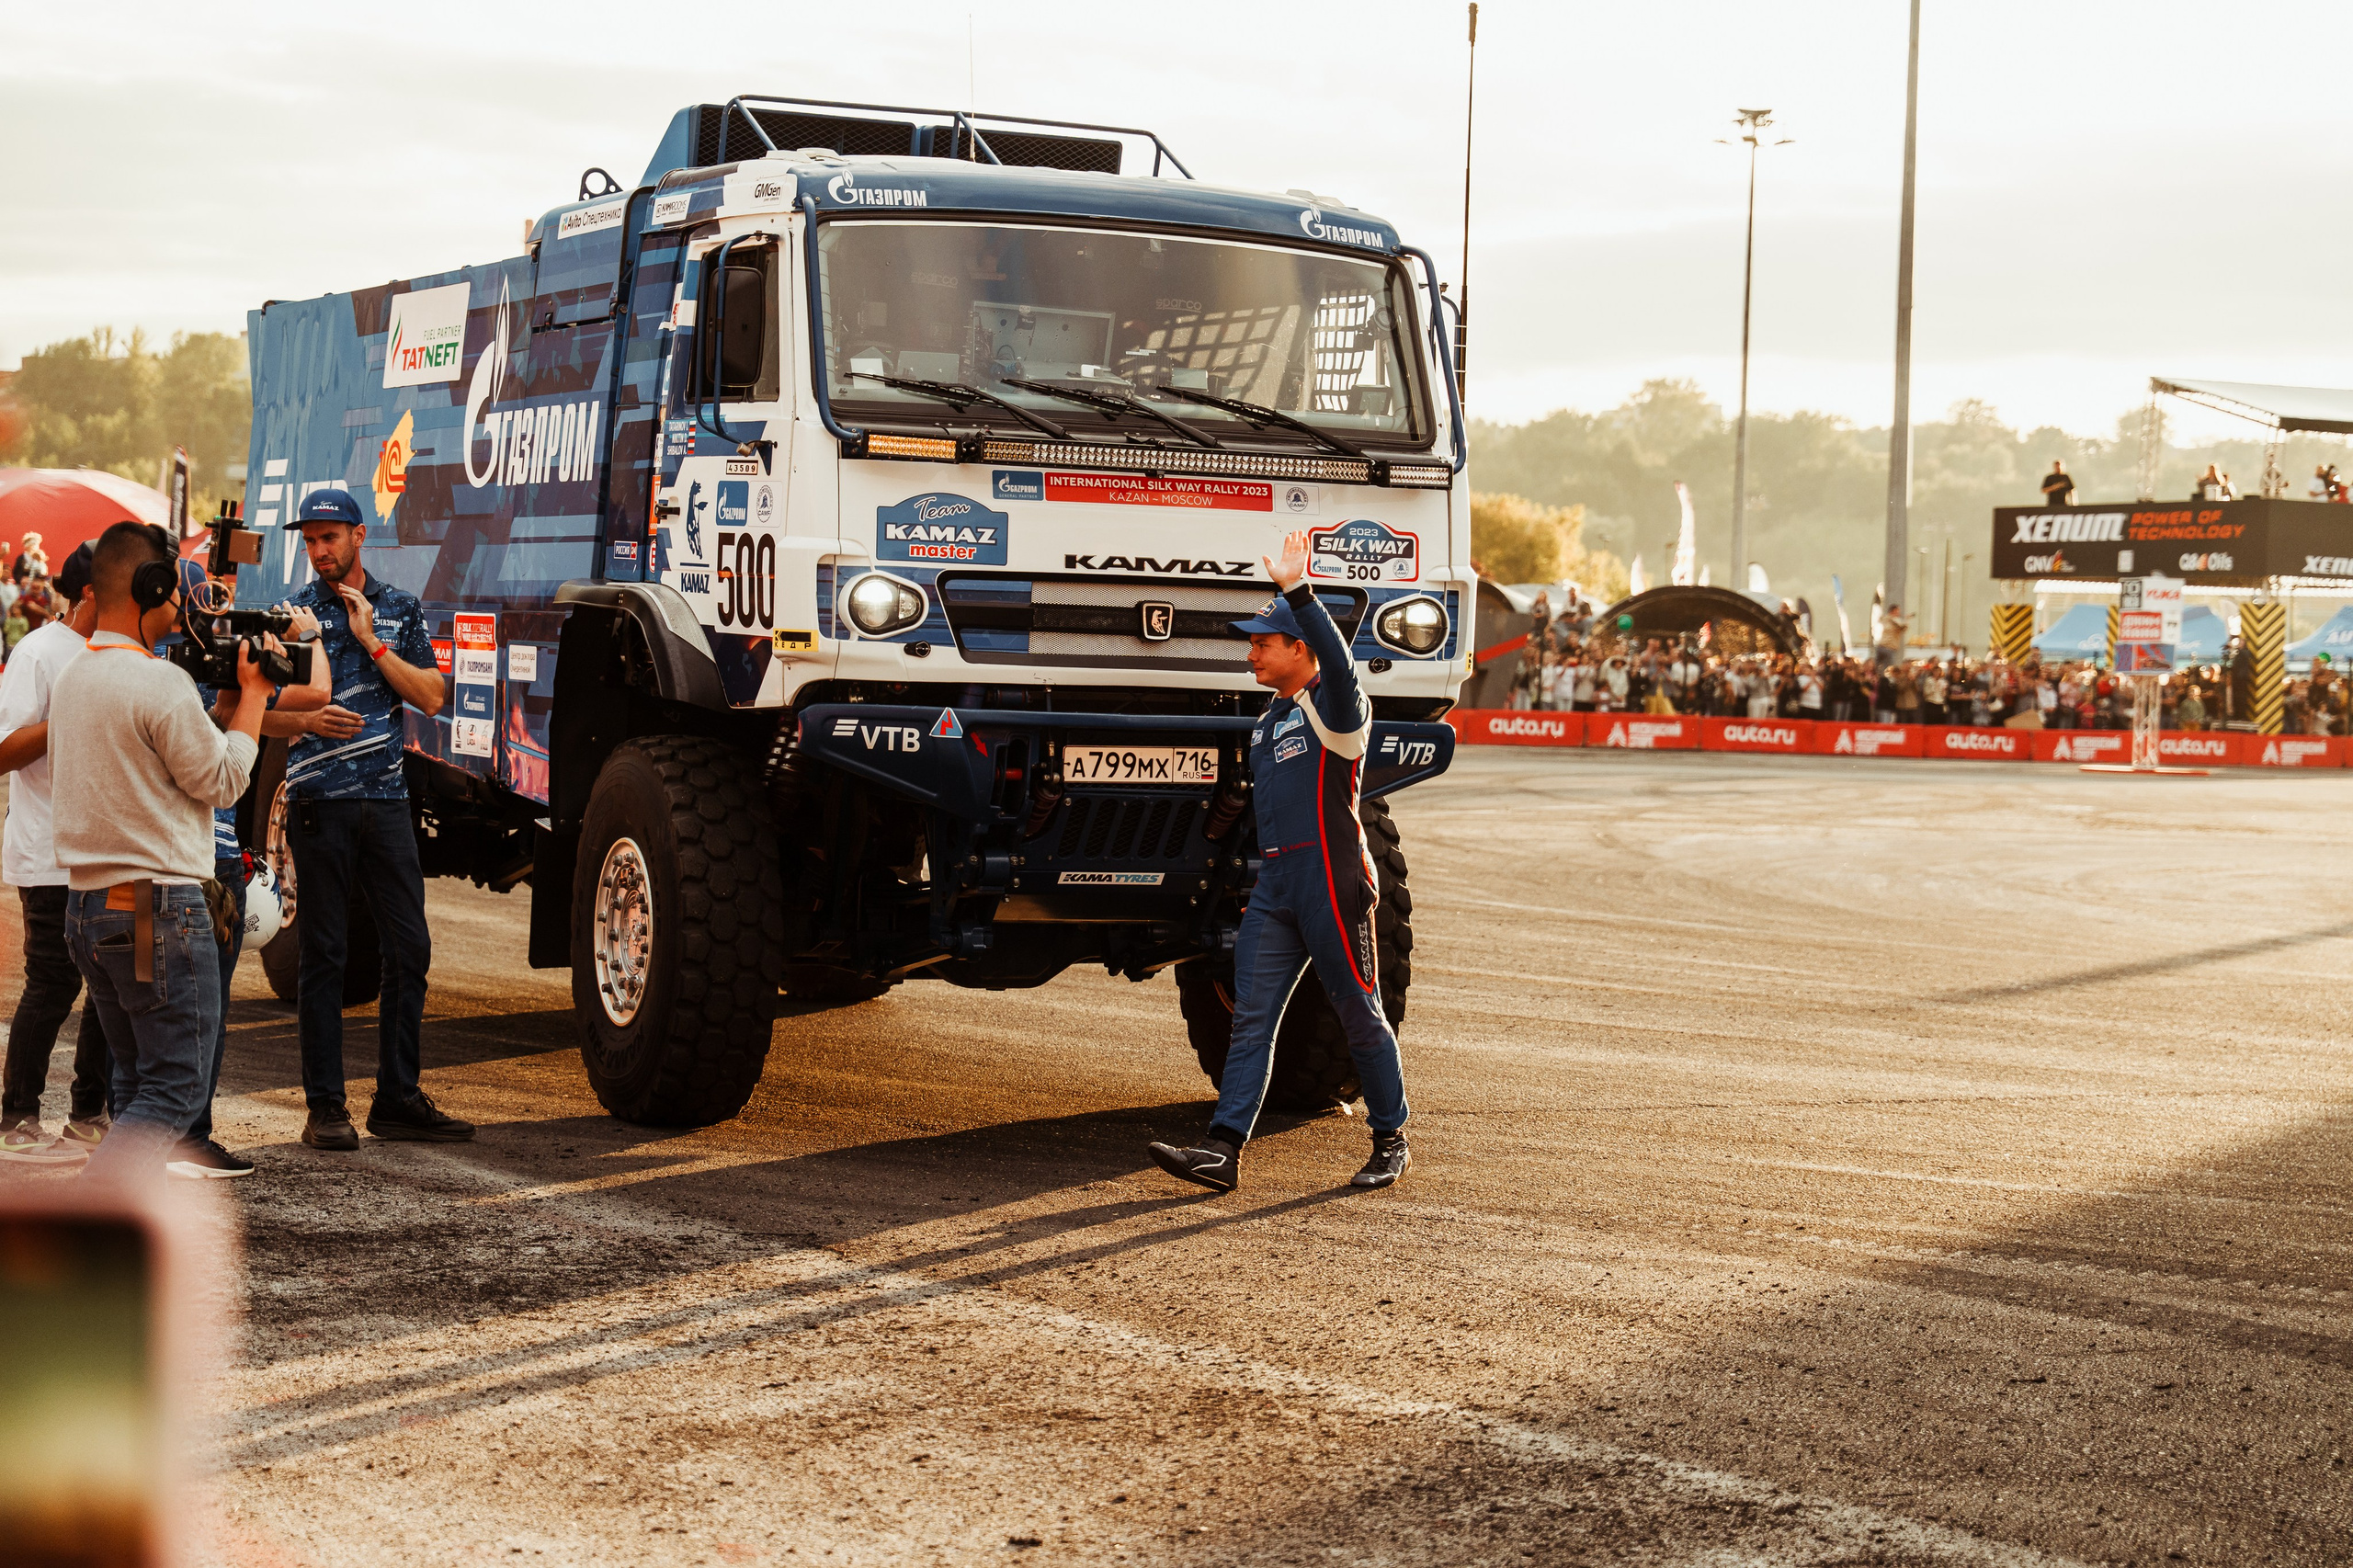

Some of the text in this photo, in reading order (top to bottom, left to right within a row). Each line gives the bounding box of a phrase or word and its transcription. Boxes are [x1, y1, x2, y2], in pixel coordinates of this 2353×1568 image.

[755, 182, 781, 199] GMGen
[859, 187, 927, 208] ГАЗПРОМ
[567, 208, 621, 230] Avito Спецтехника
[1325, 224, 1384, 248] ГАЗПРОМ
[1156, 299, 1201, 311] sparco
[424, 325, 461, 341] FUEL PARTNER
[403, 342, 460, 371] TATNEFT
[497, 401, 600, 486] ГАЗПРОМ
[728, 463, 756, 472] 43509
[1010, 484, 1038, 494] GAZPROM
[1050, 476, 1268, 496] INTERNATIONAL SILK WAY RALLY 2023
[915, 496, 971, 521] Team
[1109, 492, 1149, 503] KAZAN
[1162, 494, 1213, 506] MOSCOW
[725, 507, 746, 521] GAZPROM
[885, 523, 998, 545] KAMAZ
[1349, 528, 1379, 537] 2023
[2011, 510, 2223, 543] XENUM POWER OF
[2129, 525, 2245, 540] TECHNOLOGY
[615, 544, 631, 556] РОССИЯ
[910, 544, 976, 559] master
[1318, 537, 1409, 555] SILK WAY
[1065, 555, 1255, 576] KAMAZ
[1347, 565, 1381, 581] 500
[2302, 555, 2353, 575] XEN
[680, 572, 710, 594] KAMAZ
[717, 532, 776, 630] 500
[774, 642, 812, 650] КЕДР
[1489, 717, 1564, 737] auto.ru
[1724, 724, 1796, 745] auto.ru
[860, 725, 920, 753] VTB
[1946, 732, 2016, 753] auto.ru
[2160, 738, 2226, 756] auto.ru
[1277, 743, 1302, 756] KAMAZ
[1397, 742, 1437, 767] VTB
[1176, 751, 1211, 772] 716
[1182, 771, 1200, 779] RUS
[1063, 874, 1160, 883] KAMA TYRES
[1358, 921, 1373, 983] KAMAZ
